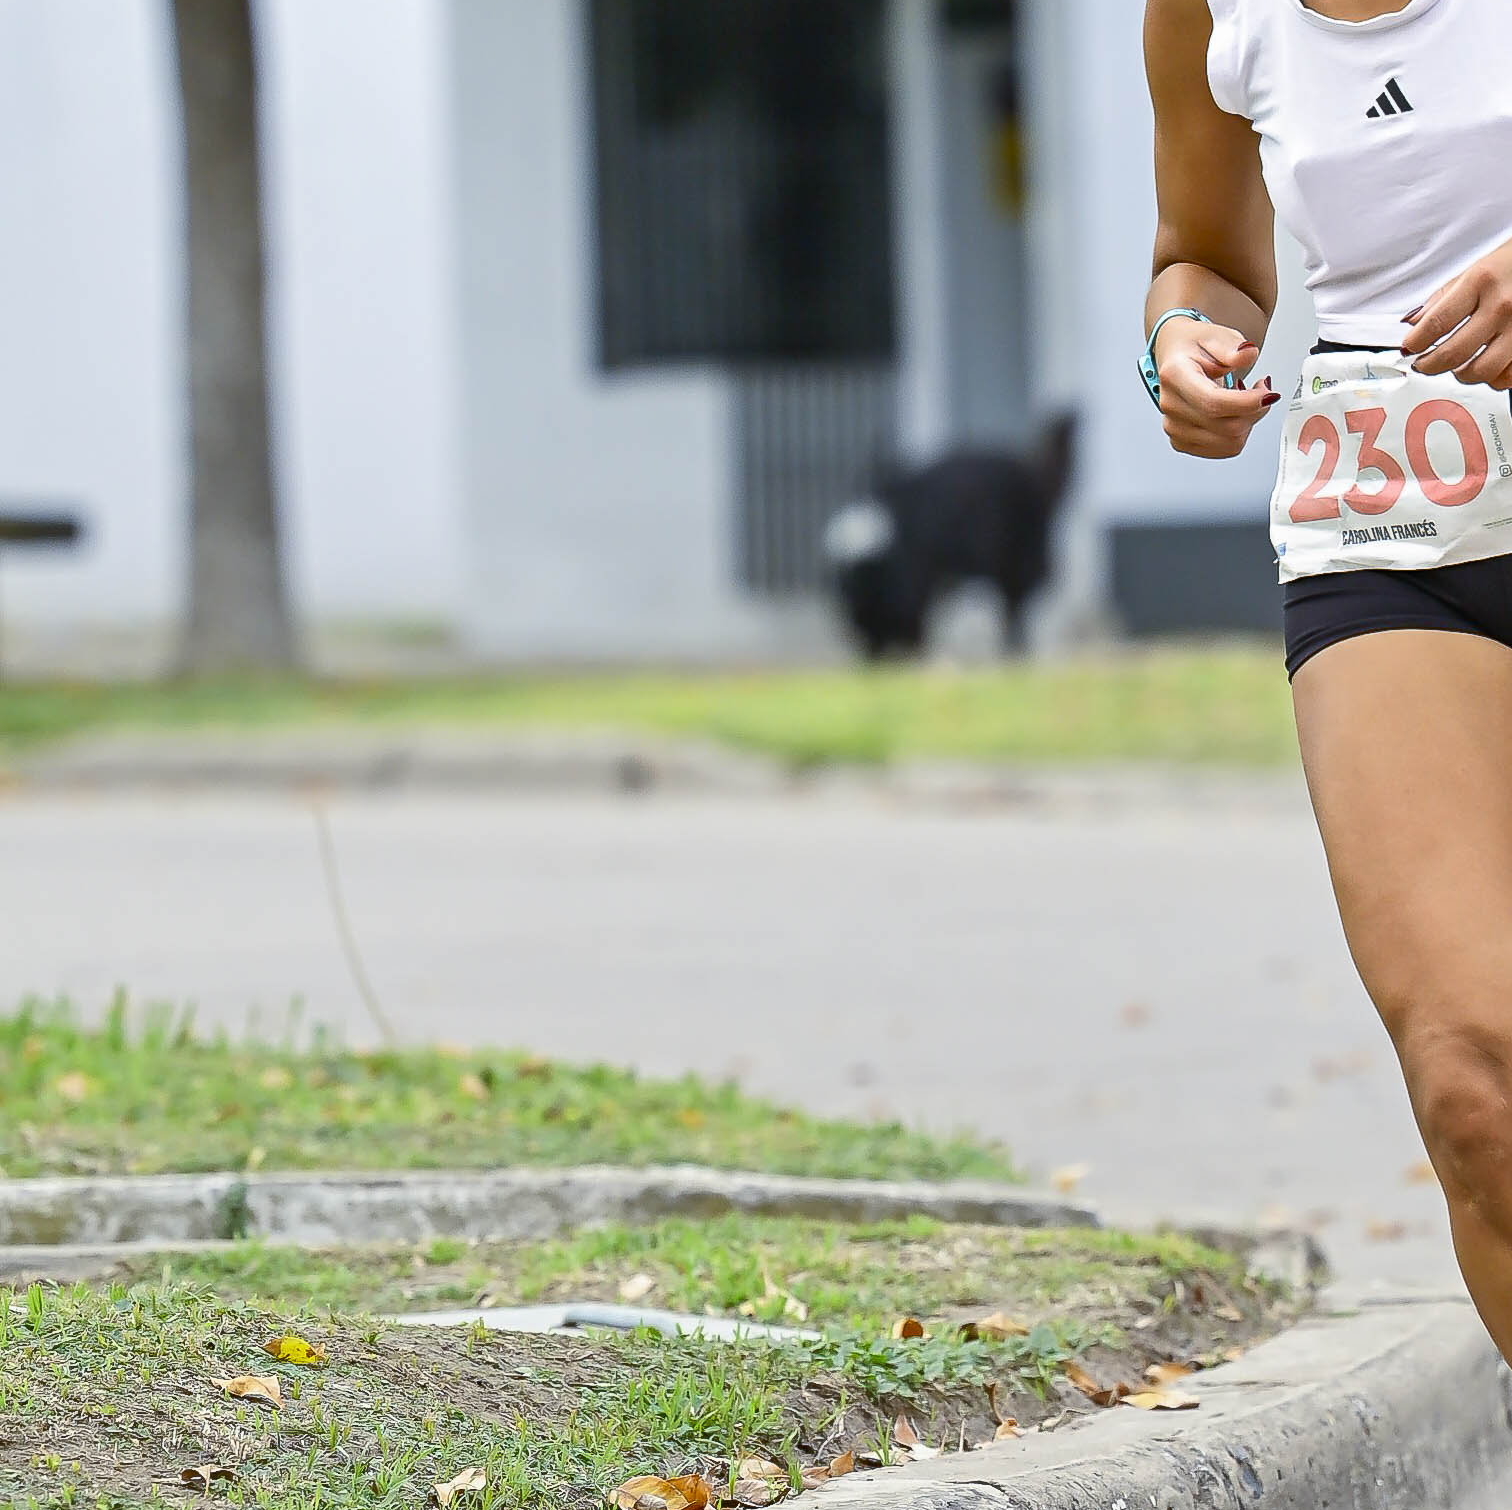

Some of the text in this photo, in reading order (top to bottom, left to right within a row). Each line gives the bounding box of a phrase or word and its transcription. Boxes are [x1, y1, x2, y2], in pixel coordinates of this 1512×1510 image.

[1289, 399, 1488, 523] 230
[1342, 519, 1438, 545] CAROLINA FRANCÉS
